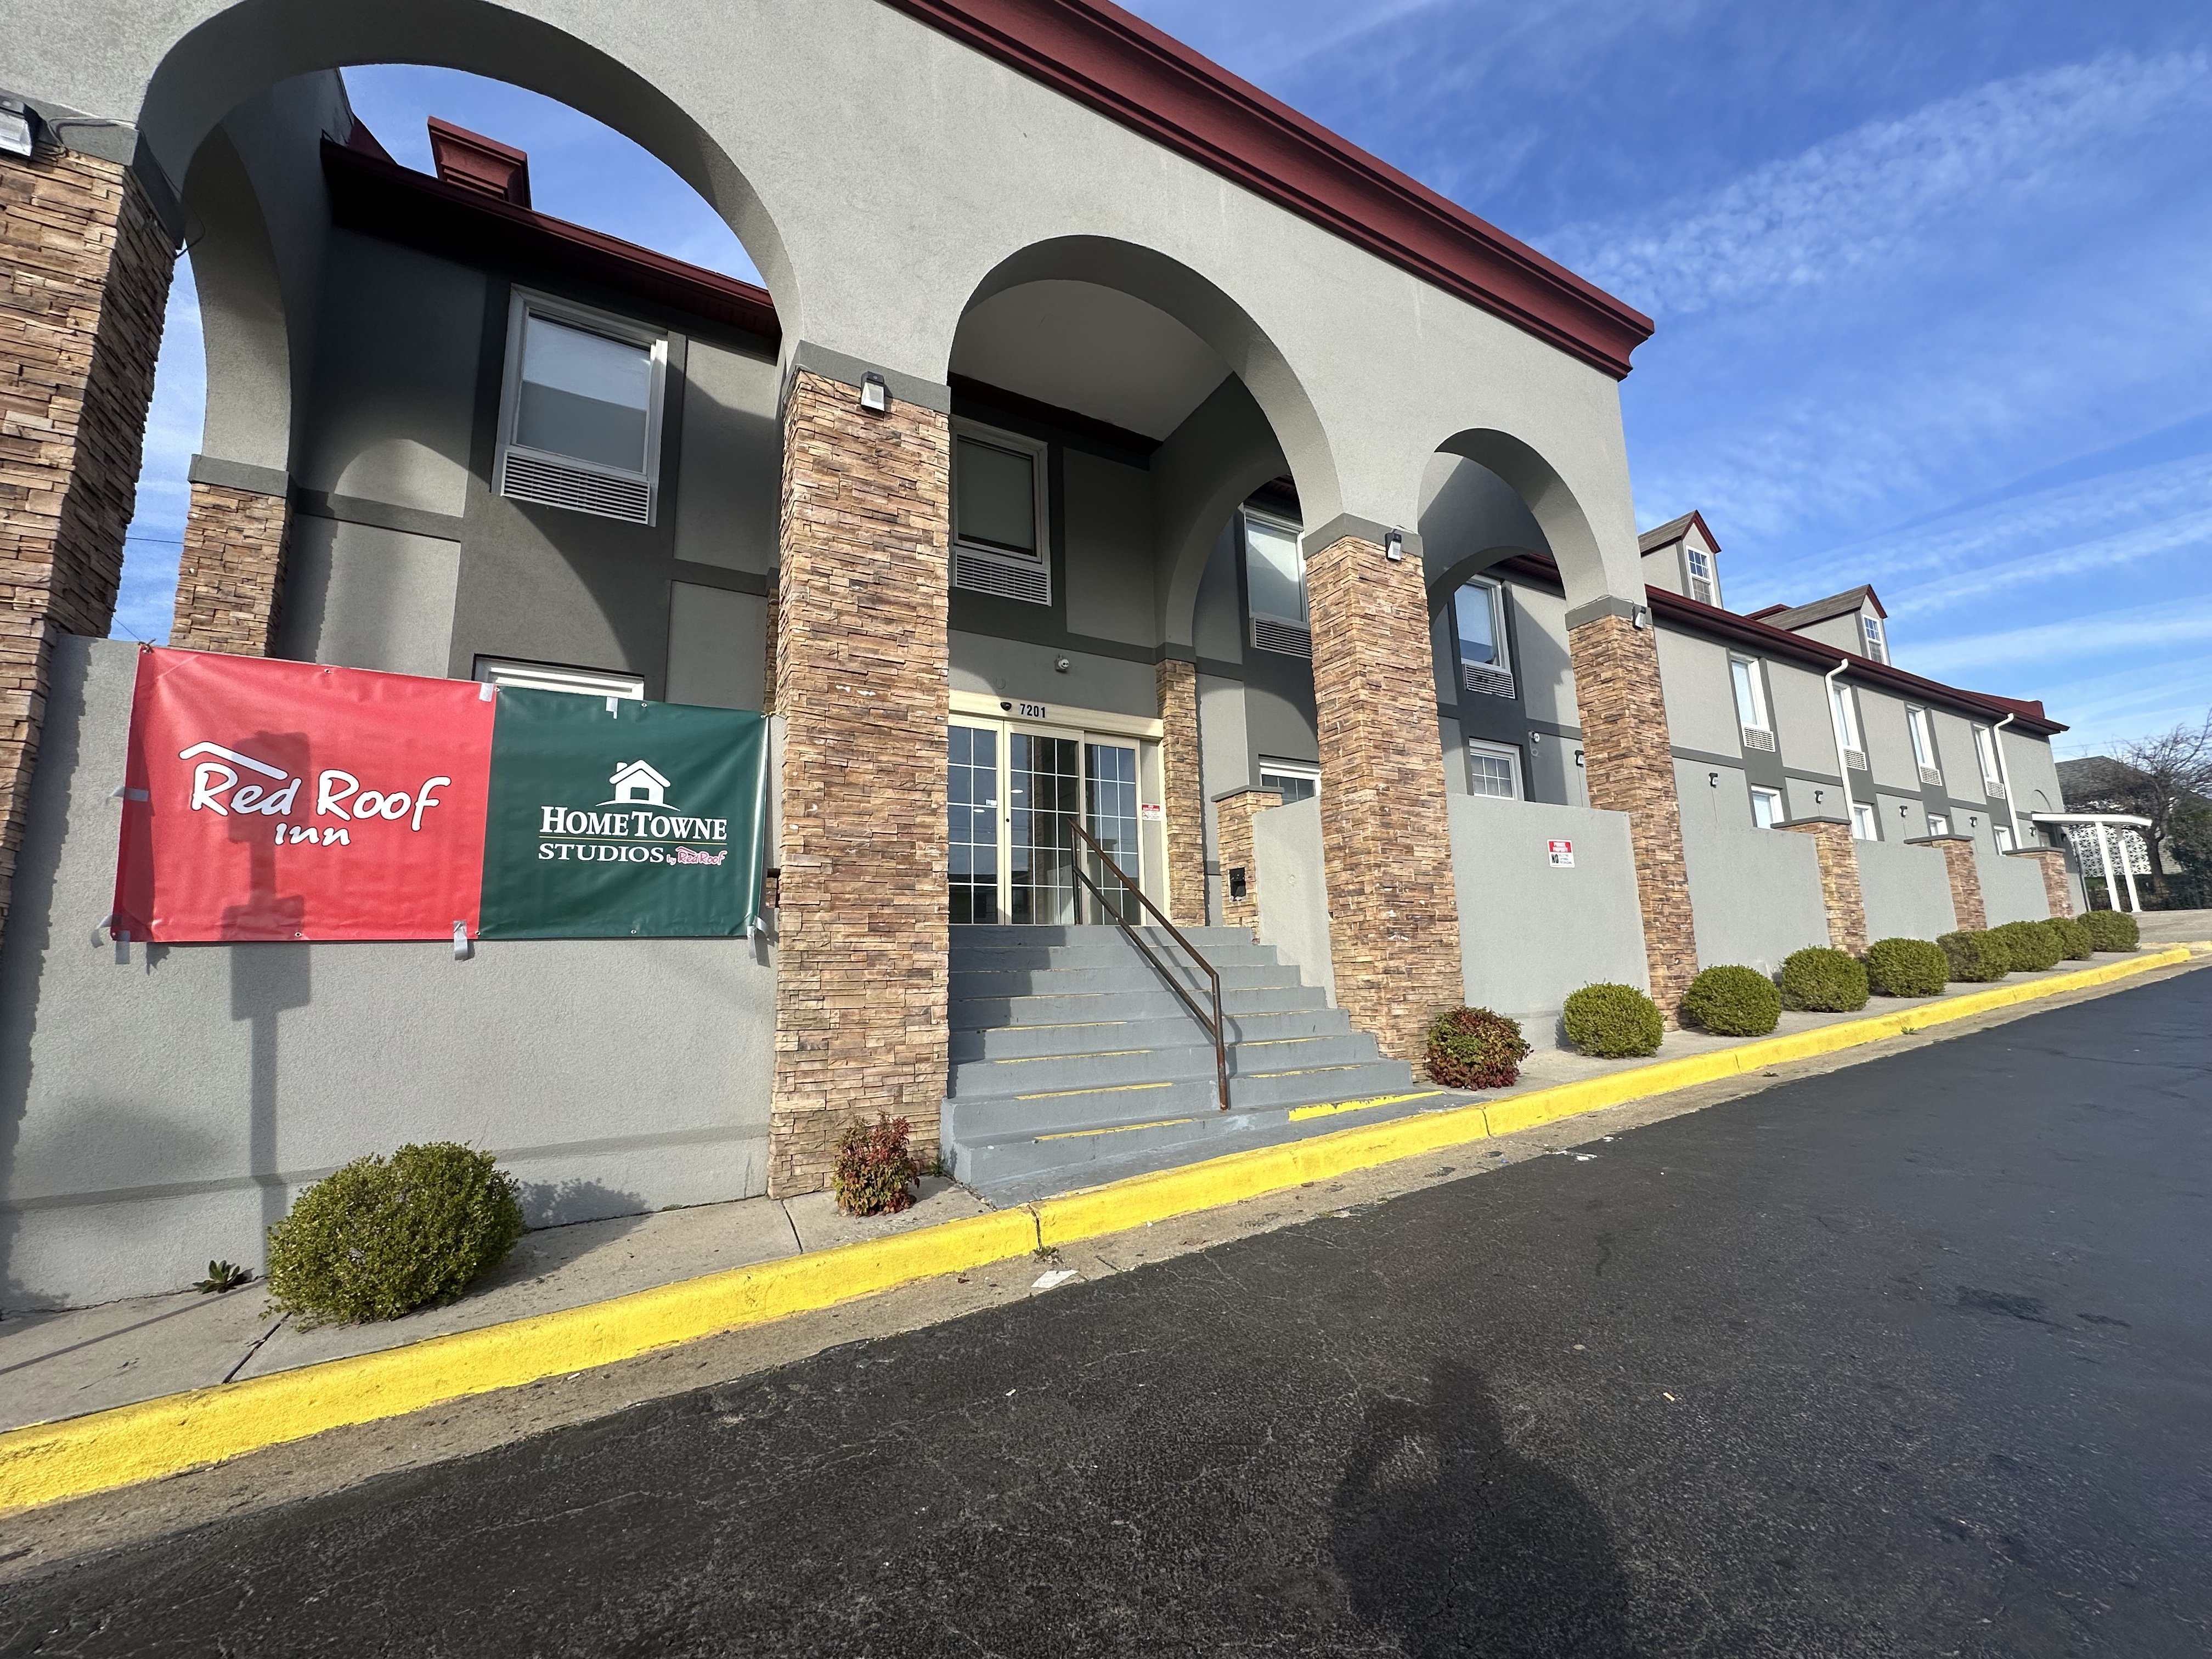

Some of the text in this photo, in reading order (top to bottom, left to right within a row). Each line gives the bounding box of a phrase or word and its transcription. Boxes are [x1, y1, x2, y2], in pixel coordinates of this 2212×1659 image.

[1020, 703, 1045, 718] 7201
[191, 761, 451, 831] Red Roof
[538, 843, 727, 865] STUDIOS by Red Roof
[1551, 854, 1559, 864] NO
